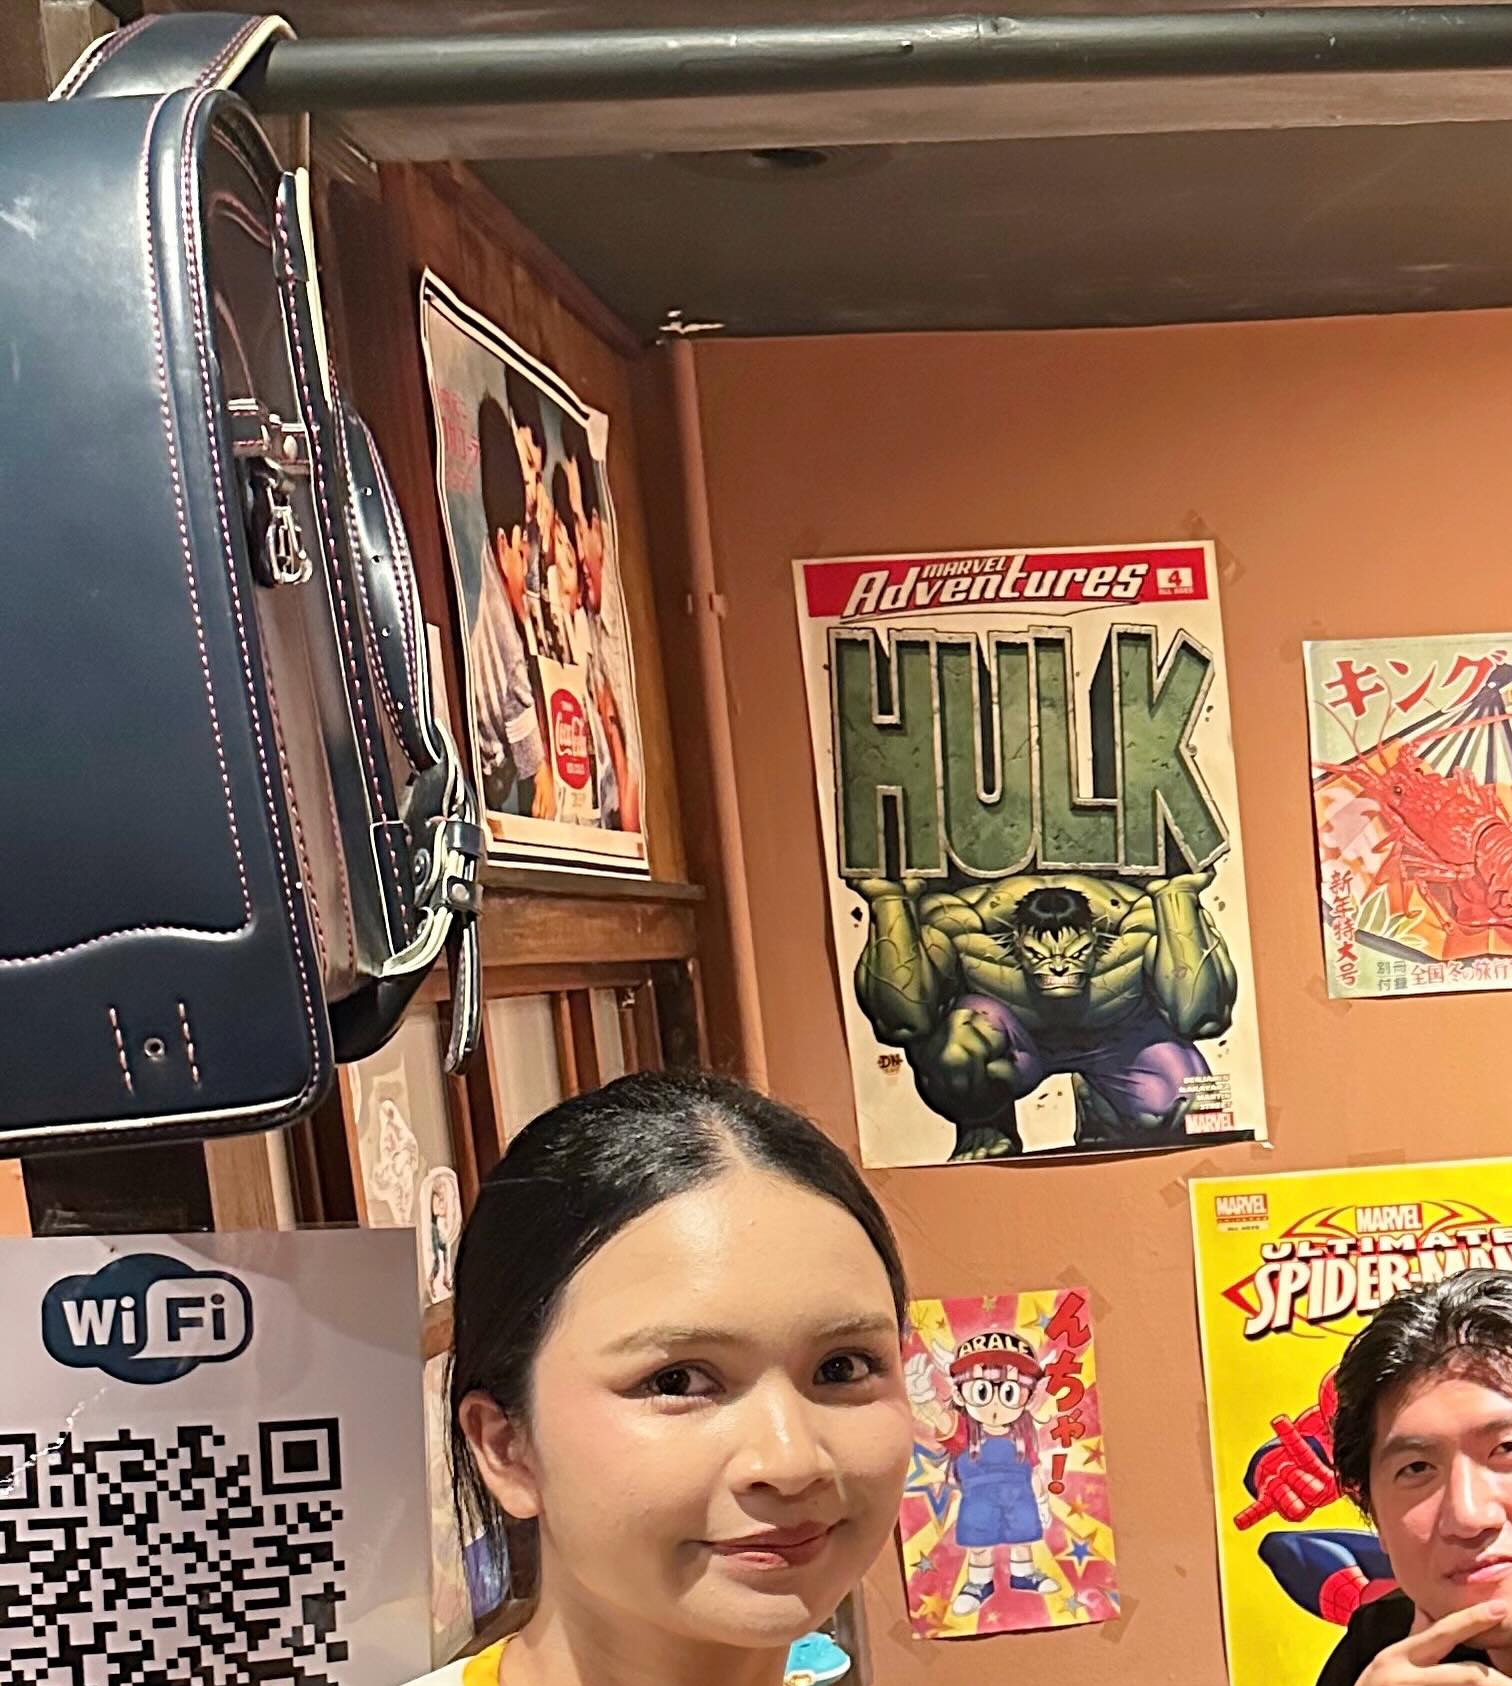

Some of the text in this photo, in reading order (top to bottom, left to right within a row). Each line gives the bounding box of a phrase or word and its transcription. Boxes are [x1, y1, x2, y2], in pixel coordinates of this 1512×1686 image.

[921, 555, 1007, 579] MARVEL
[1167, 570, 1183, 586] 4
[843, 554, 1148, 619] Adventures
[1325, 649, 1508, 718] キング
[827, 622, 1232, 879] HULK
[1185, 1112, 1234, 1134] MARVEL
[1215, 1195, 1267, 1217] MARVEL
[1355, 1203, 1423, 1234] MARVEL
[61, 1292, 227, 1347] WiFi
[958, 1333, 1033, 1358] ARALE
